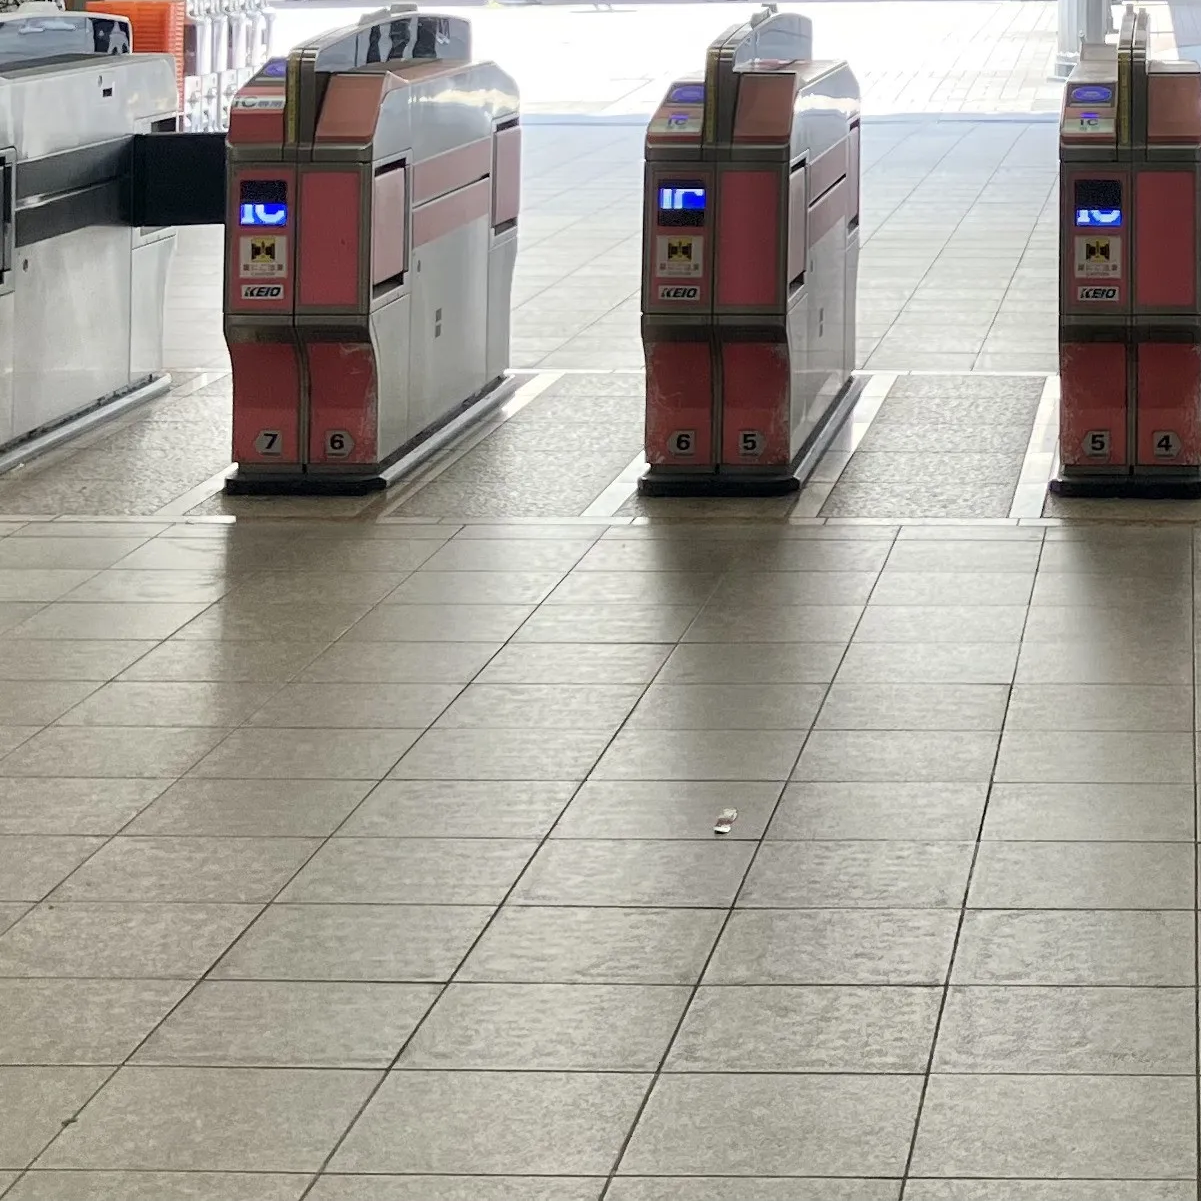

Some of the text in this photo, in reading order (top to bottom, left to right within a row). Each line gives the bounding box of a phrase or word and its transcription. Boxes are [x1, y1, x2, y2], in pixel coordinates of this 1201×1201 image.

[244, 286, 281, 297] KEIO
[661, 287, 698, 298] KEIO
[1080, 288, 1117, 299] KEIO
[263, 433, 278, 449] 7
[330, 434, 345, 450] 6
[676, 434, 691, 451] 6
[742, 433, 757, 450] 5
[1090, 434, 1105, 451] 5
[1156, 434, 1173, 451] 4
